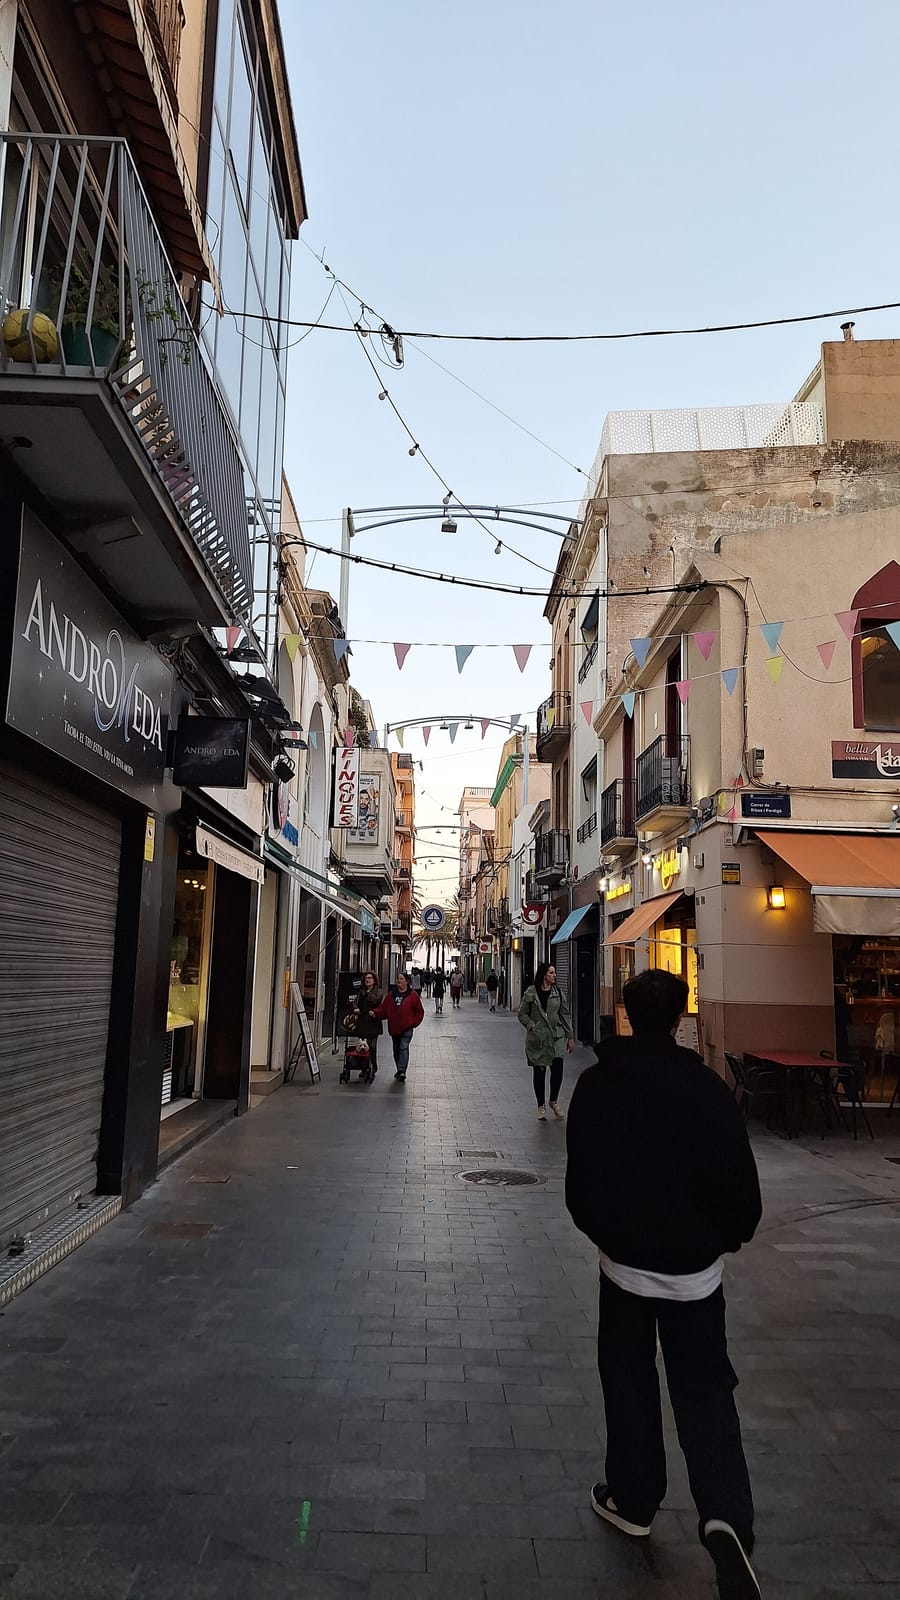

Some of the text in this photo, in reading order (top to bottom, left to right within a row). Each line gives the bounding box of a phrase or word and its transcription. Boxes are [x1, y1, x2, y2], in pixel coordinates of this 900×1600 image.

[183, 745, 240, 757] ANDROEDA
[845, 743, 869, 754] bella
[337, 748, 355, 827] FINQUES
